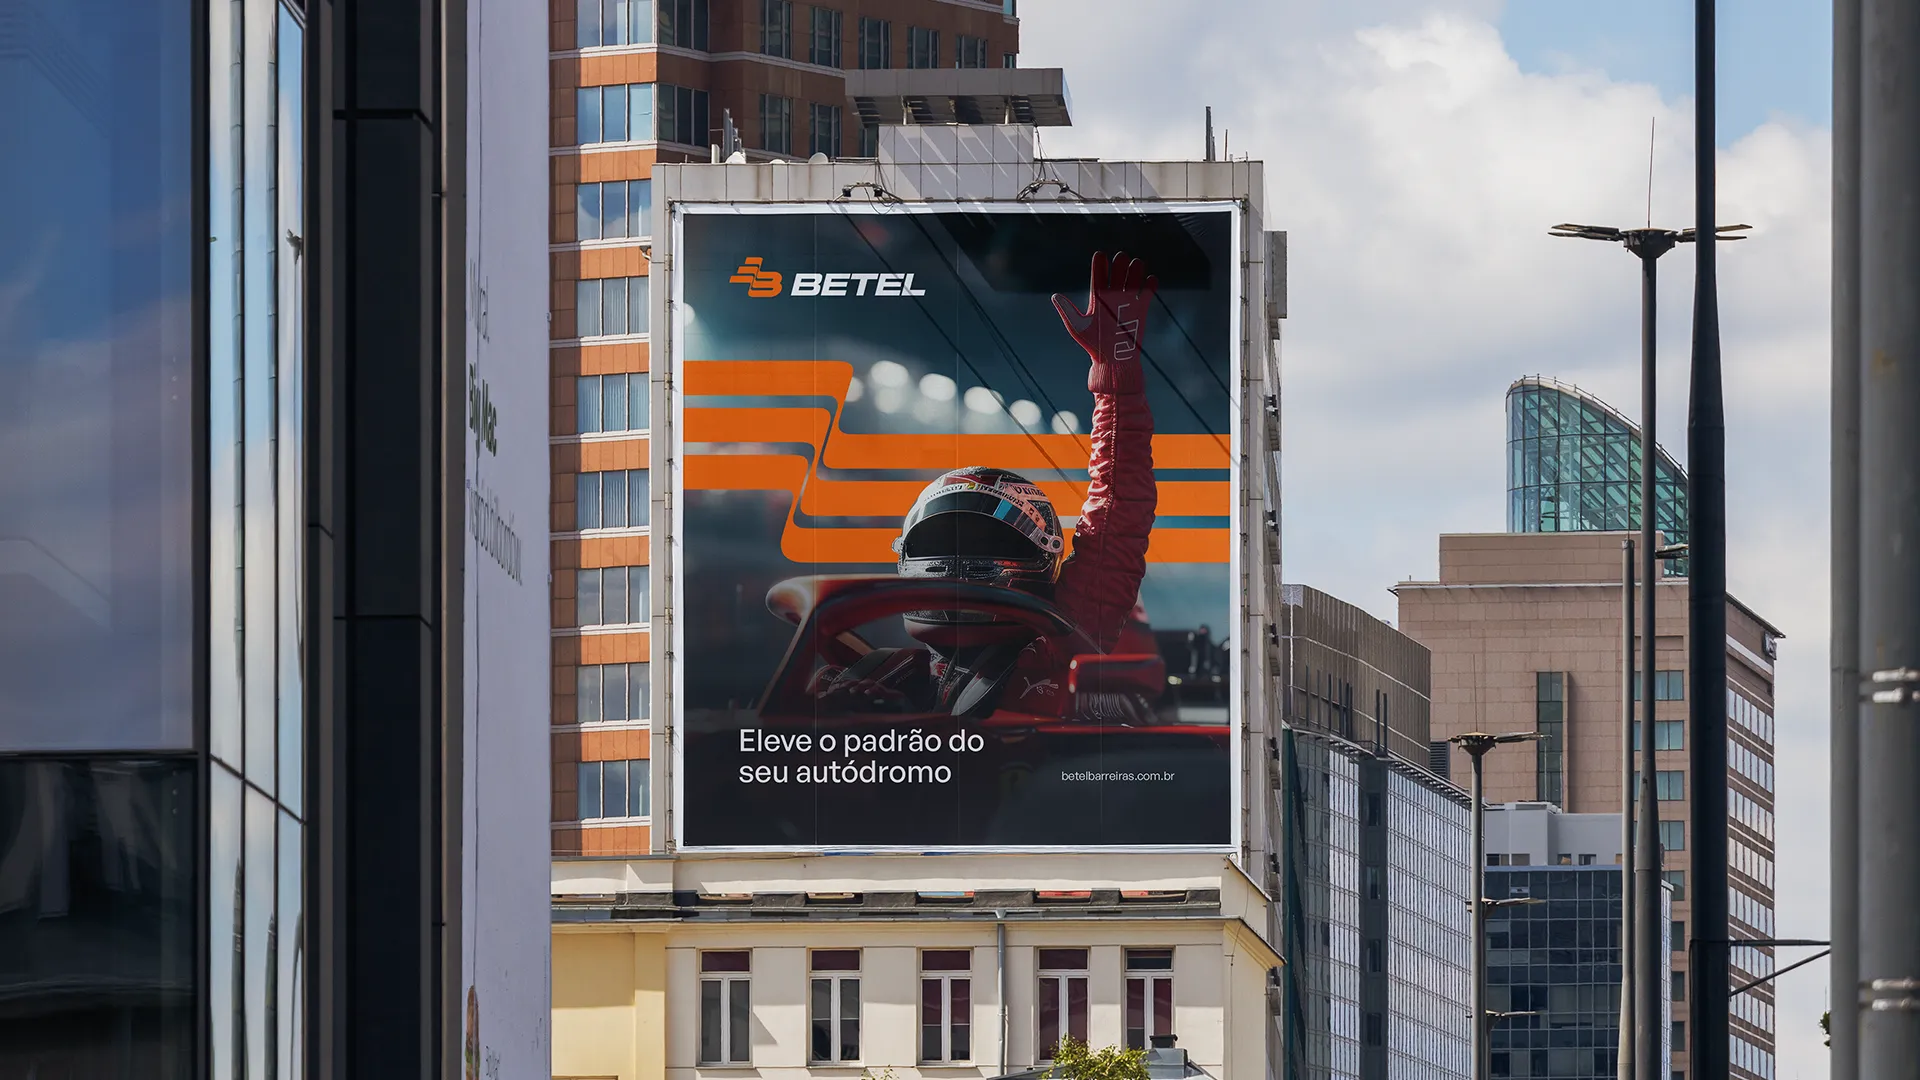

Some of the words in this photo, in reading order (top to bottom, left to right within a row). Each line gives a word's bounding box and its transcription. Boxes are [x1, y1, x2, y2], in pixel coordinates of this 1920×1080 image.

[790, 272, 926, 297] BETEL
[481, 379, 497, 457] Mac
[740, 728, 812, 753] Eleve
[819, 734, 837, 753] o
[844, 728, 942, 758] padrão
[948, 728, 985, 753] do
[739, 765, 788, 784] seu
[796, 759, 952, 784] autódromo
[1061, 770, 1176, 783] betelbarreiras.com.br
